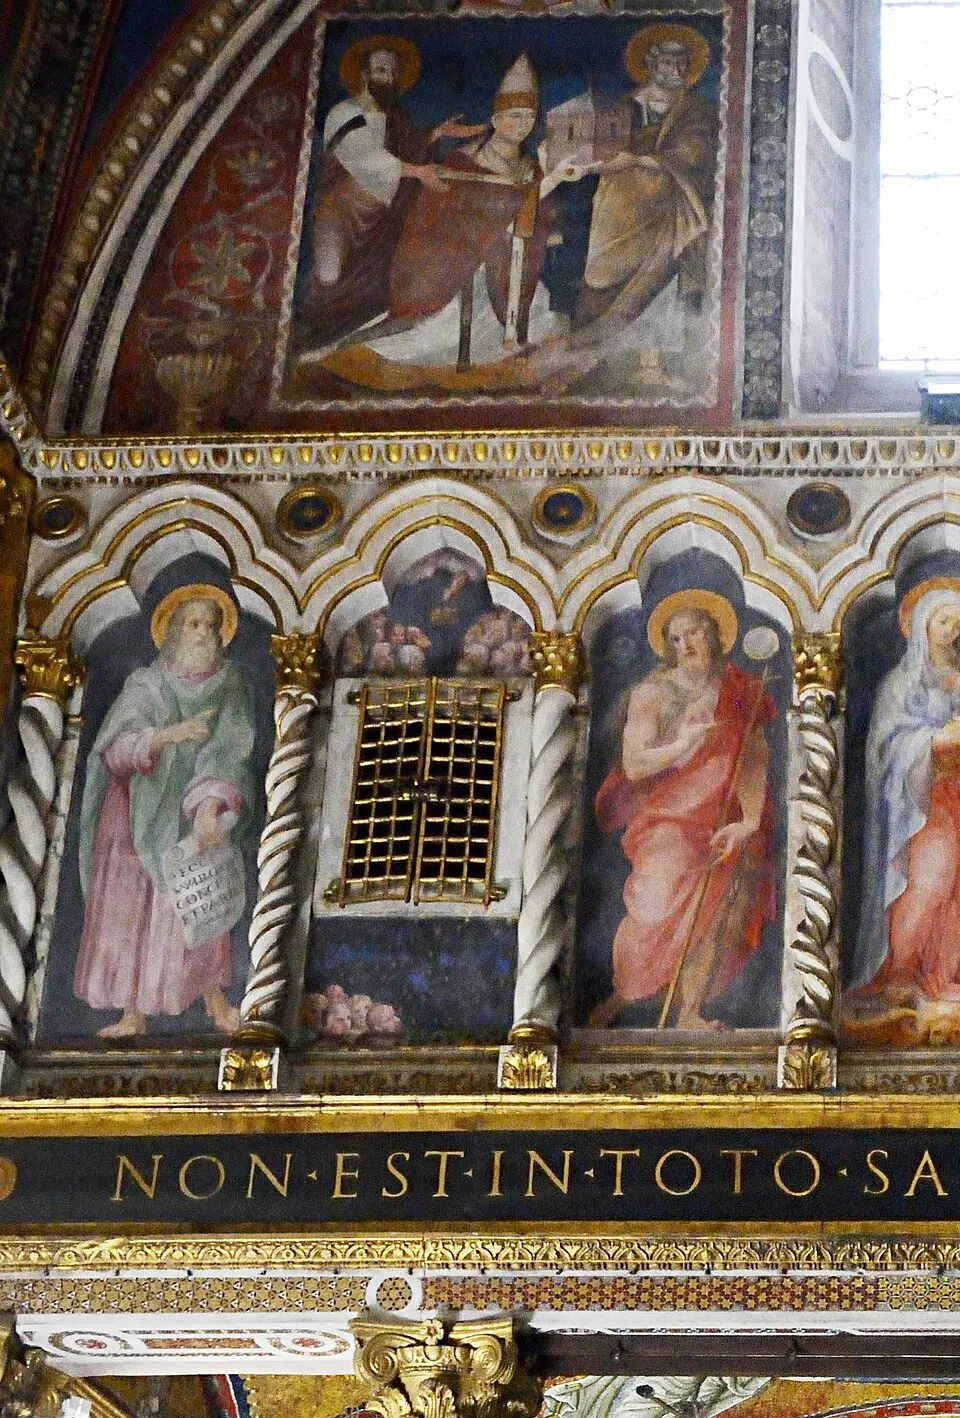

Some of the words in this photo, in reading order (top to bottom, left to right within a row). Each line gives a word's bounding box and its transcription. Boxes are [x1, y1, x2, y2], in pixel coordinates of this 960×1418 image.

[111, 1153, 293, 1202] NON
[332, 1150, 465, 1199] EST
[490, 1149, 575, 1198] IN
[600, 1148, 821, 1197] TOTO
